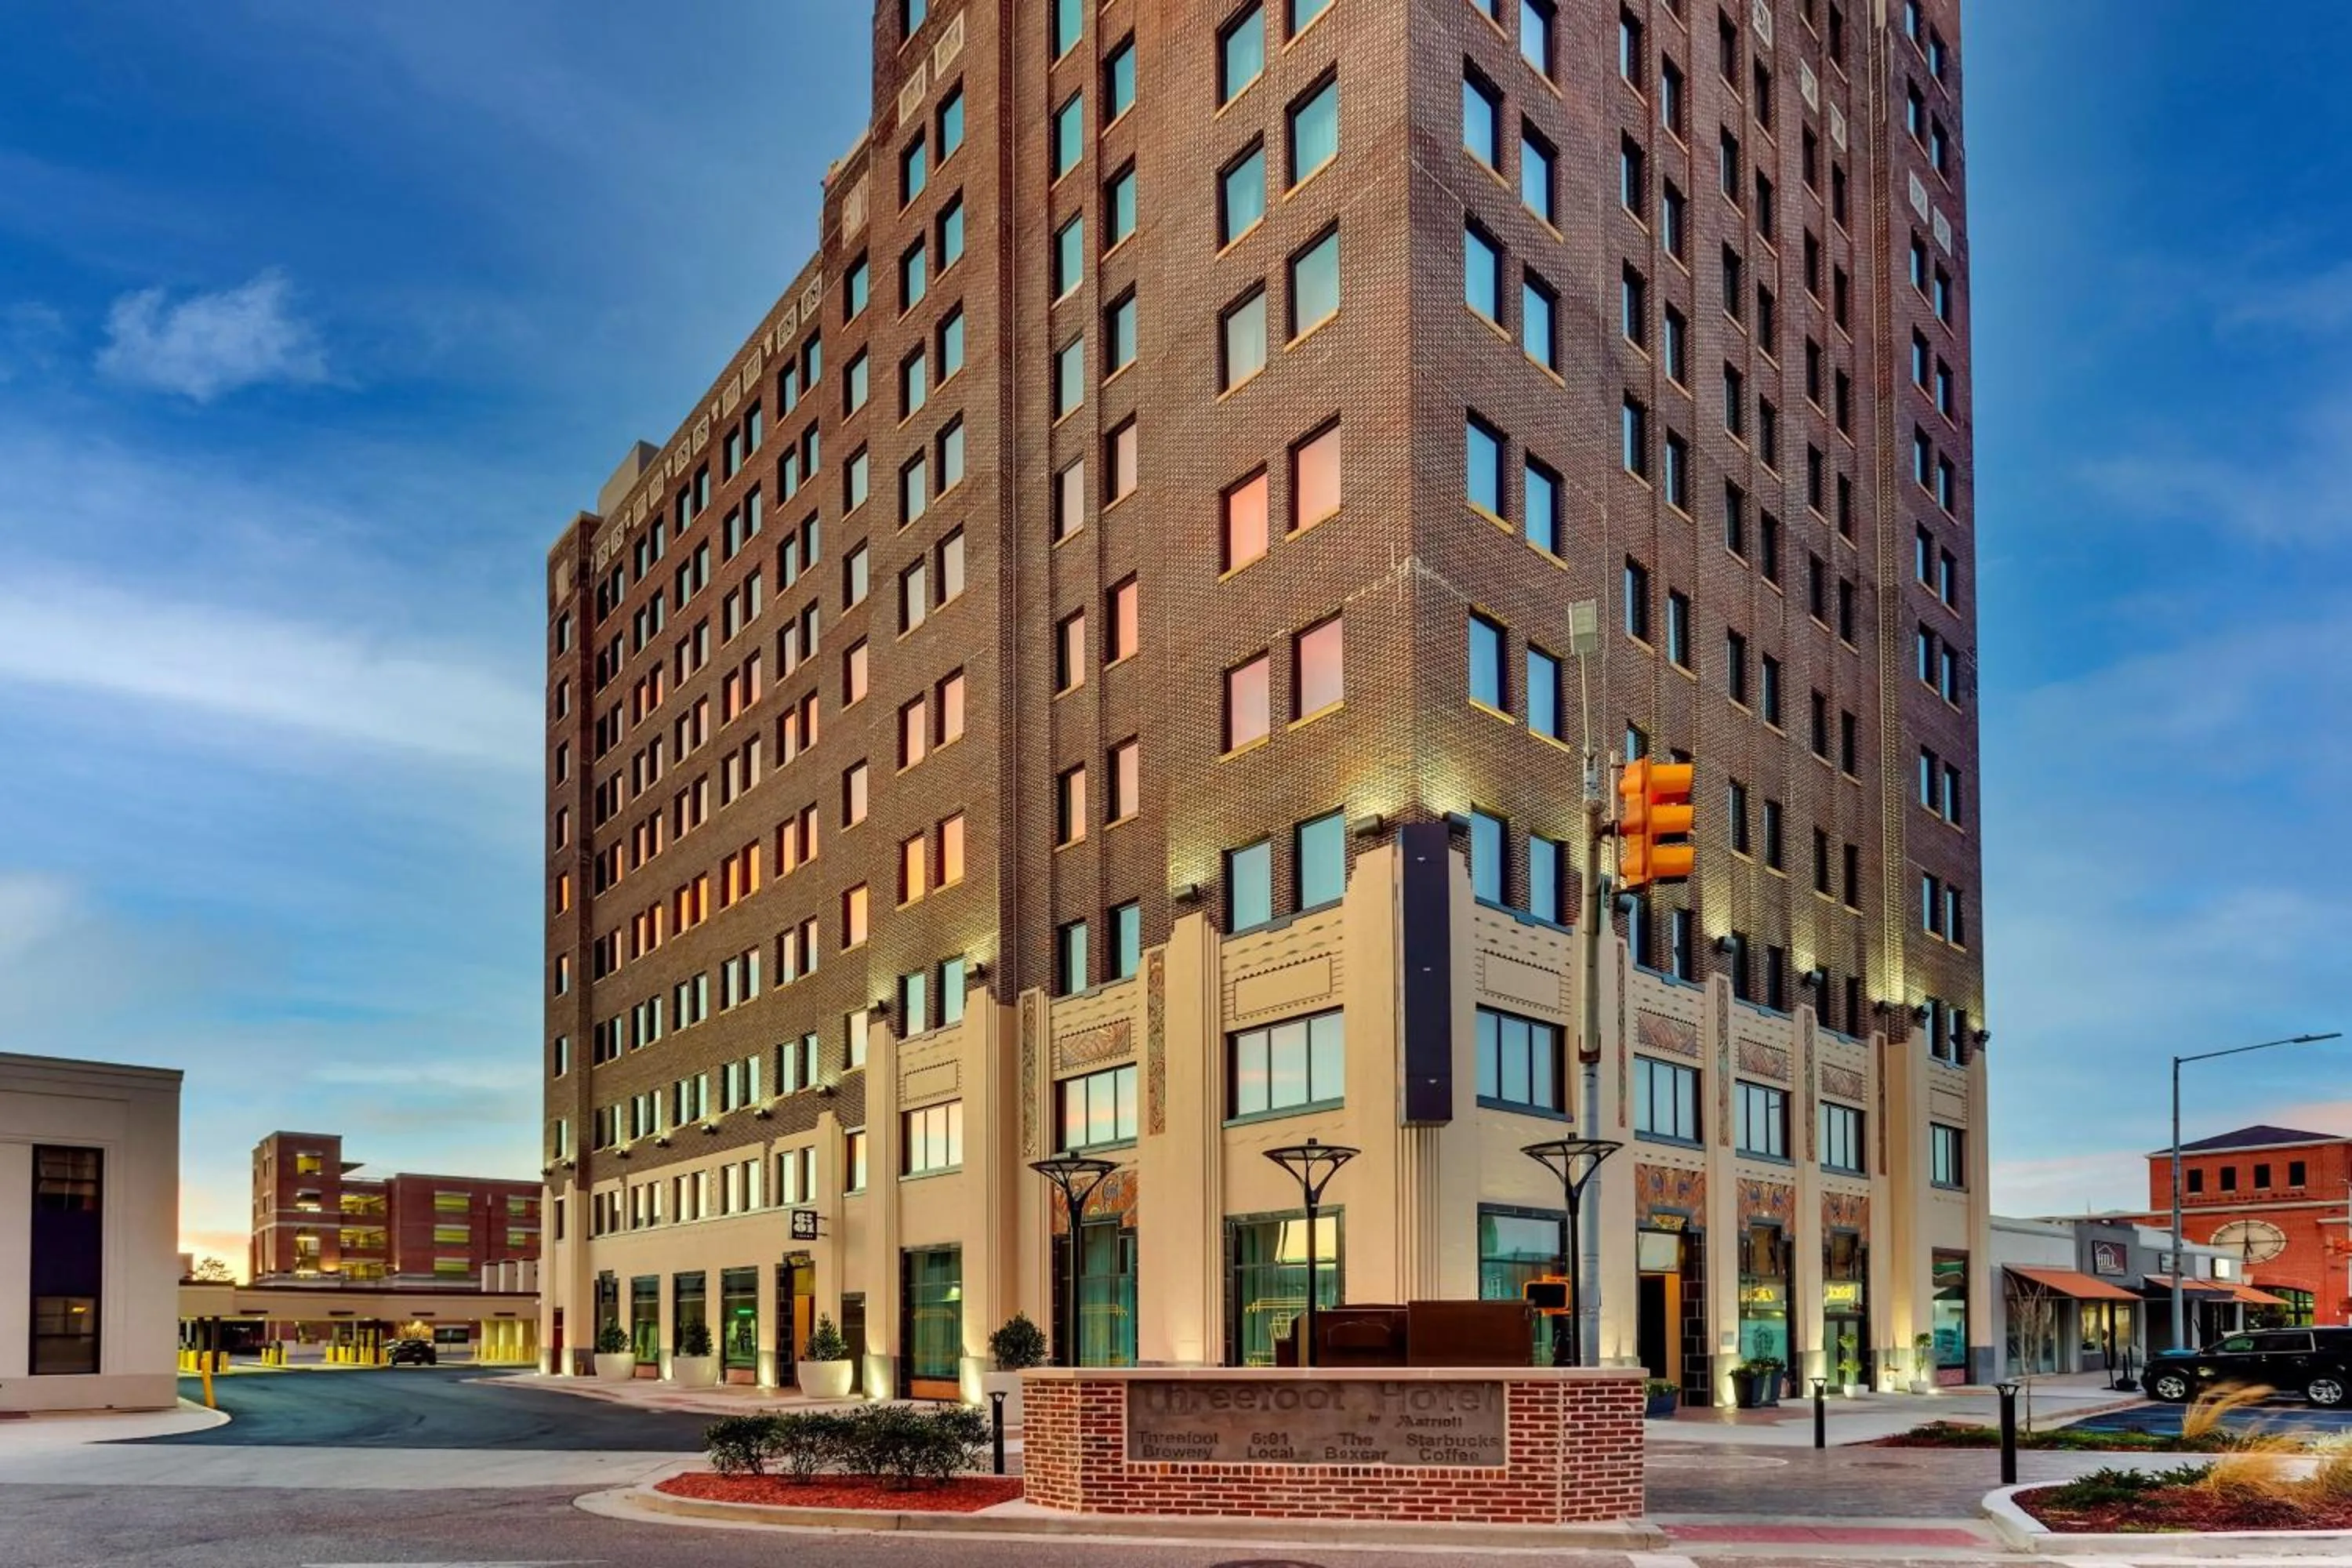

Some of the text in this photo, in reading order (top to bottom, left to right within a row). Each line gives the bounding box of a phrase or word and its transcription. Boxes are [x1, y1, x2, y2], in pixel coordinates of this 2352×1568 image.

[1137, 1431, 1219, 1445] Threefoot
[1337, 1432, 1374, 1446] The
[1406, 1433, 1501, 1448] Starbucks
[1247, 1446, 1294, 1459] Local
[1418, 1447, 1480, 1462] Coffee
